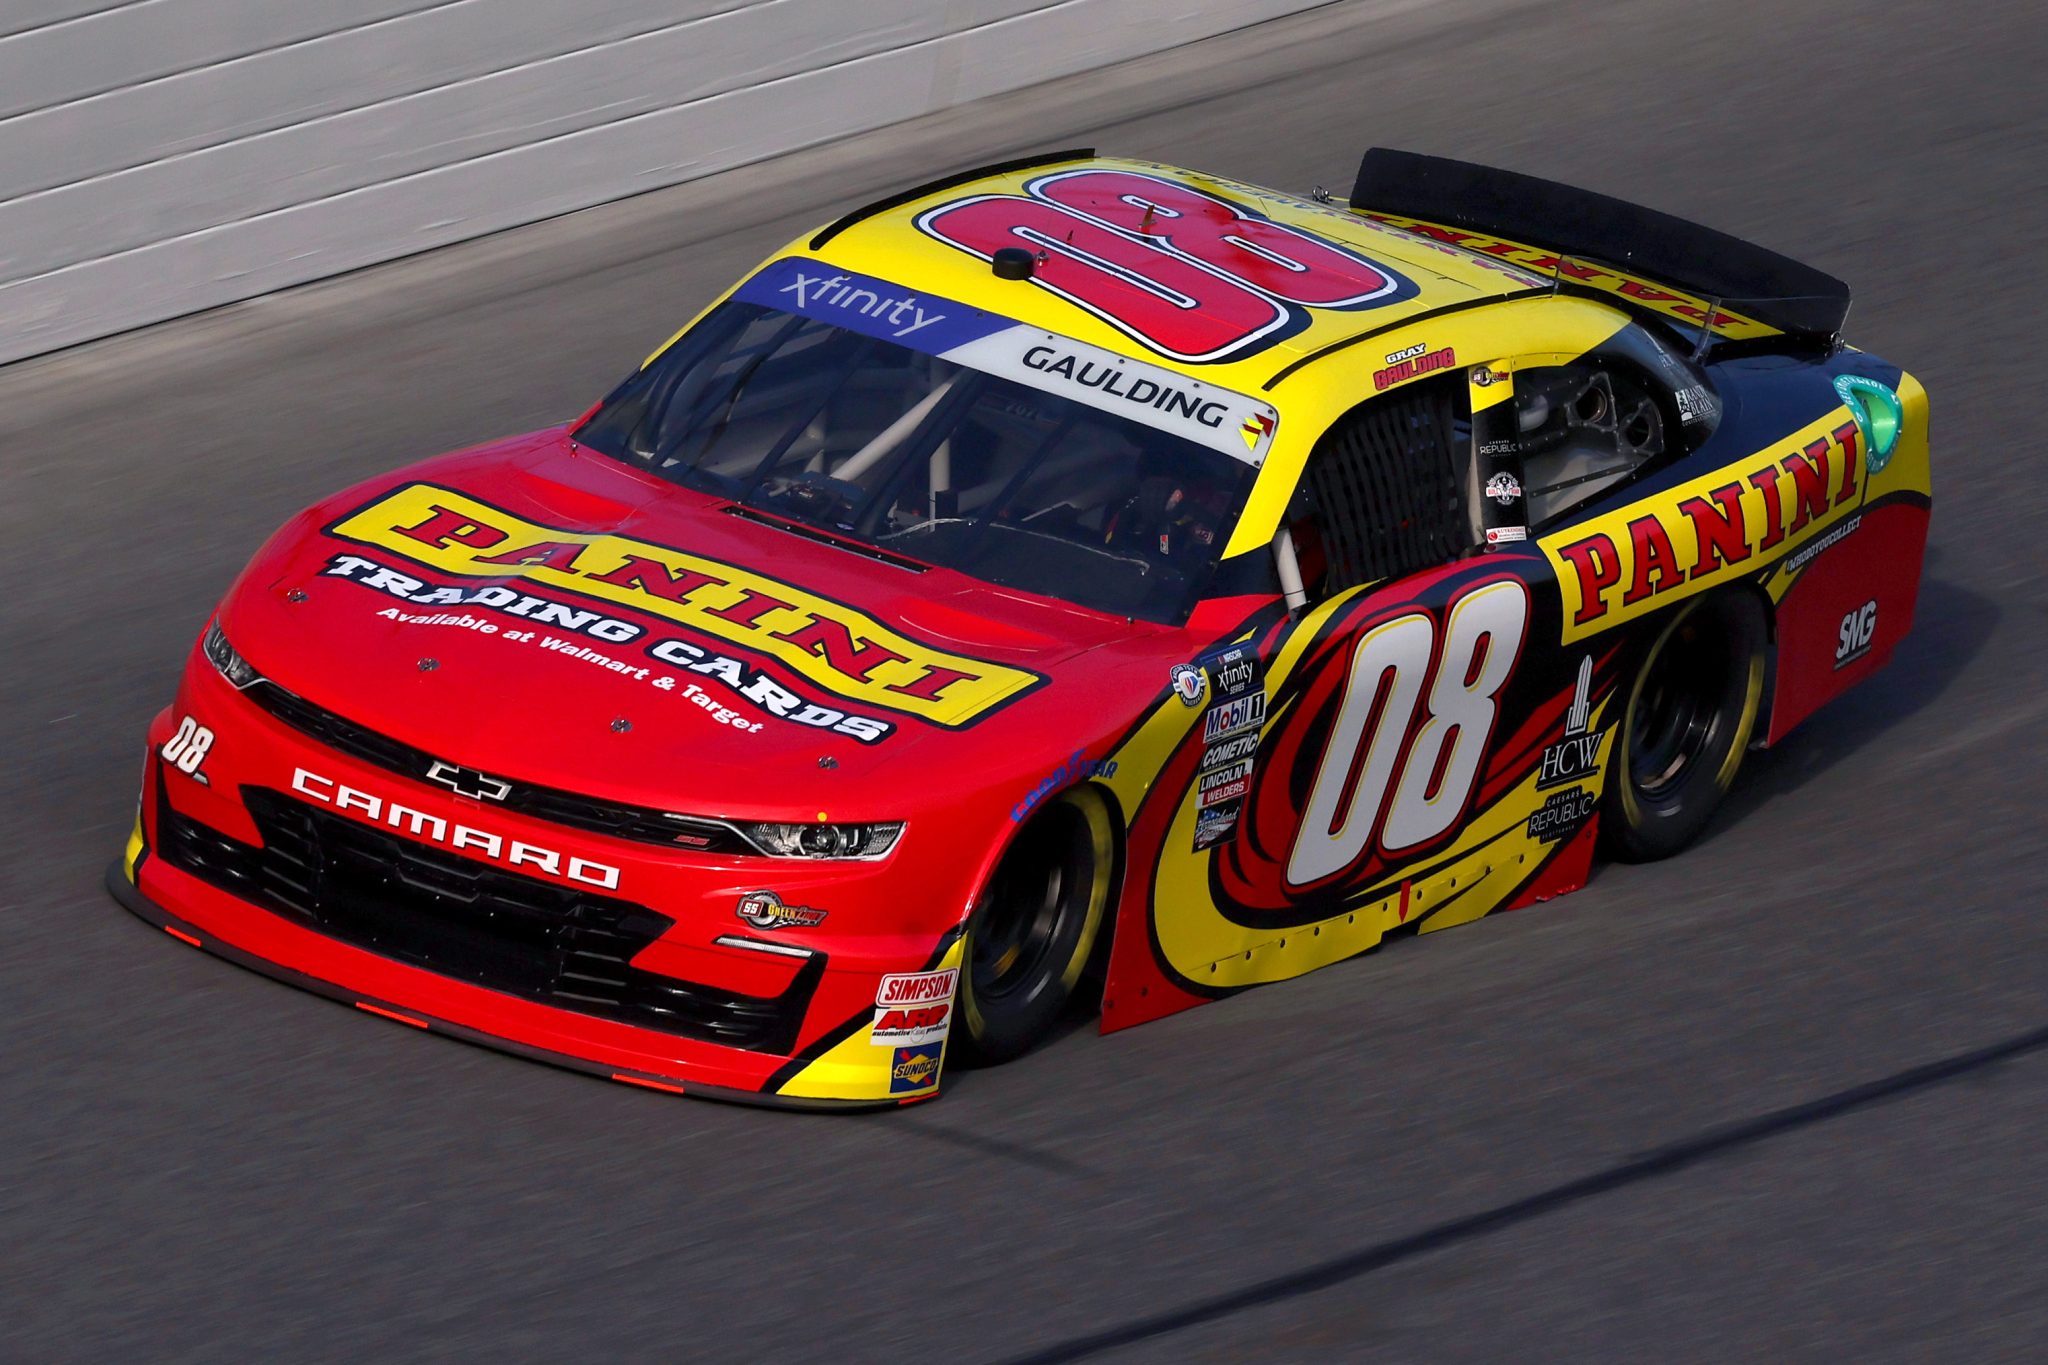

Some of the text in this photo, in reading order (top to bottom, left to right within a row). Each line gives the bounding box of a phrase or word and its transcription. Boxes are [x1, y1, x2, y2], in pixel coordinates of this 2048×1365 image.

[915, 168, 1400, 363] 08
[780, 272, 946, 337] xfinity
[1373, 347, 1456, 391] GAULDING
[1386, 343, 1425, 363] GRAY
[1021, 345, 1228, 429] GAULDING
[1480, 443, 1517, 454] REPUBLIC
[1558, 420, 1860, 627] PANINI
[390, 504, 982, 701] PANINI
[326, 556, 889, 741] TRADING CARDS
[1836, 600, 1877, 659] SMG
[376, 607, 764, 734] Available at Walmart & Target
[1218, 661, 1254, 691] xfinity
[1229, 684, 1246, 695] SERIES
[1204, 696, 1250, 738] Mobil
[1253, 695, 1262, 717] 1
[1287, 581, 1527, 886] 08
[161, 715, 214, 774] 08
[1203, 733, 1258, 768] COMETIC
[1540, 732, 1603, 782] HCW
[1201, 763, 1243, 791] LINCOLN
[1207, 781, 1245, 803] WELDERS
[1529, 796, 1594, 834] REPUBLIC
[1547, 791, 1580, 808] CAESARS
[291, 767, 621, 890] CAMARO
[743, 902, 764, 916] SS
[885, 973, 953, 1001] SIMPSON
[874, 1003, 950, 1031] ARP
[895, 1059, 937, 1078] SUNOCO
